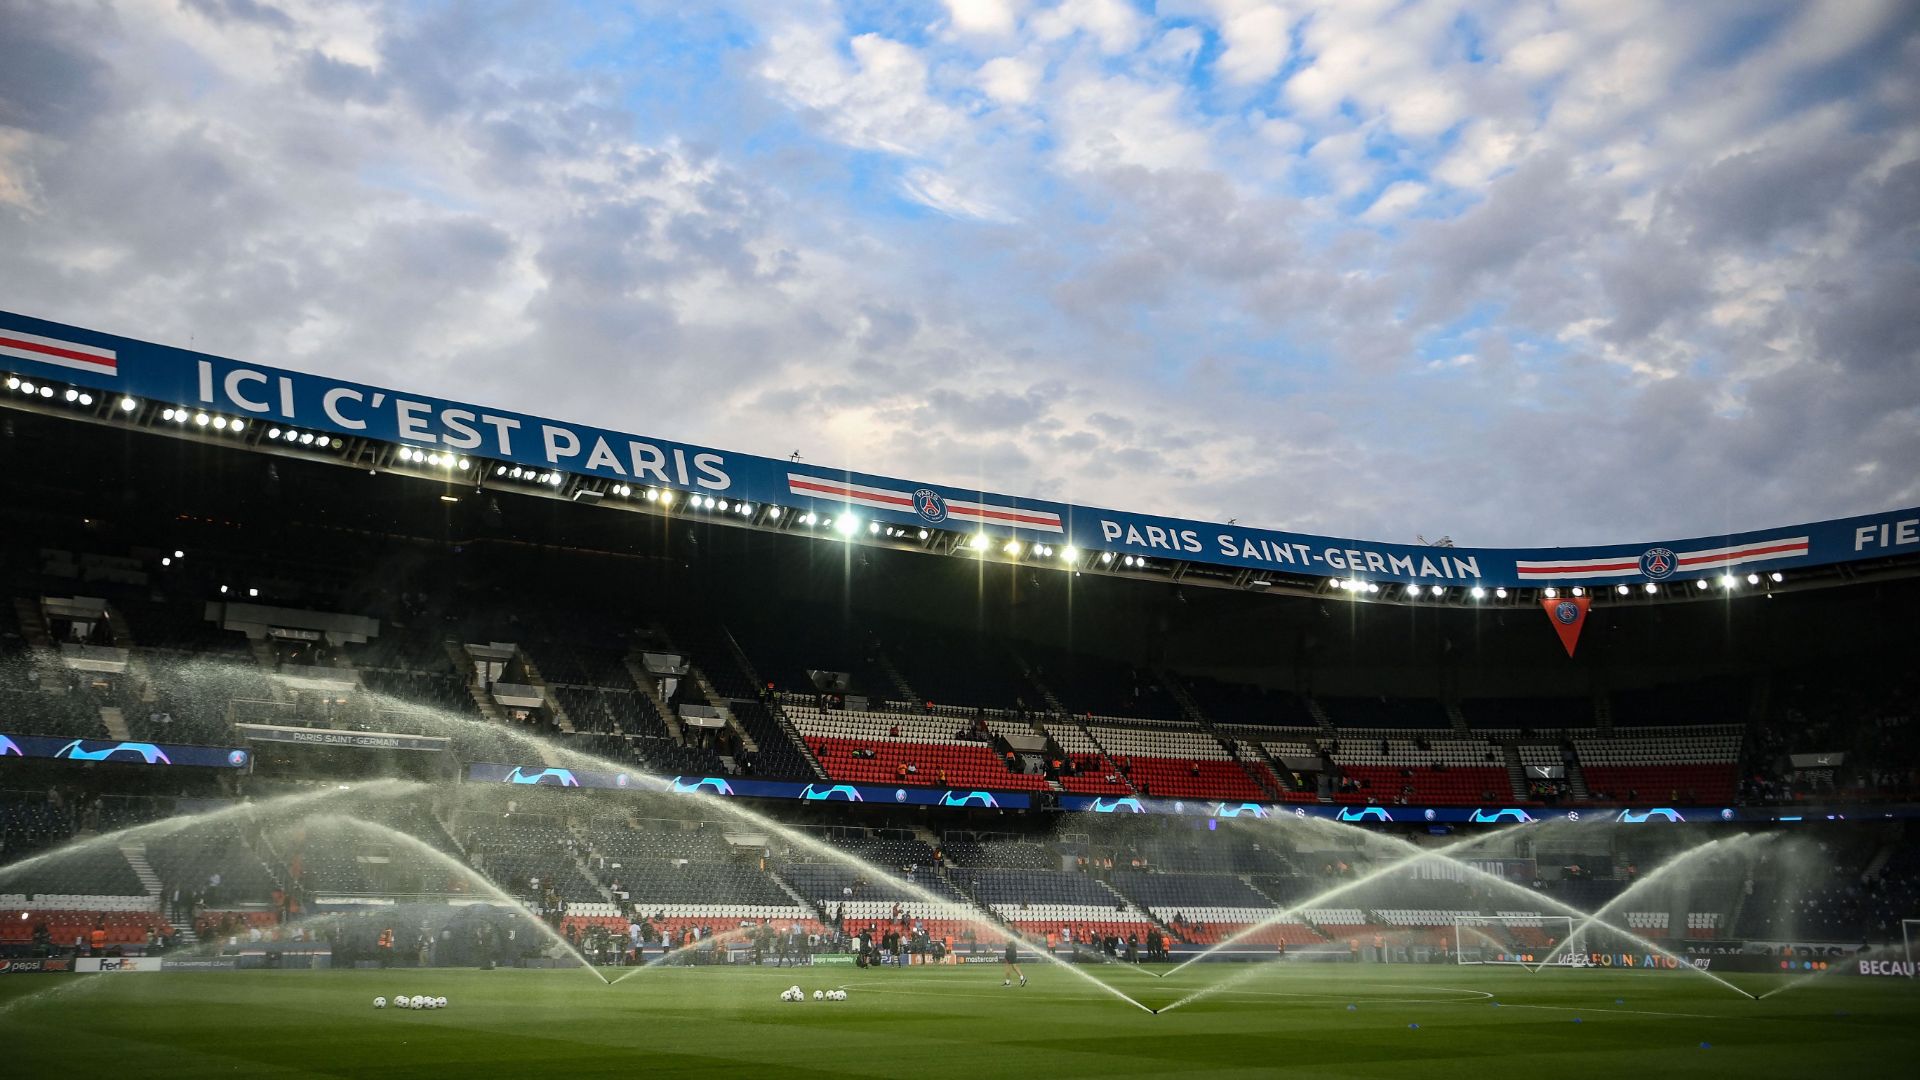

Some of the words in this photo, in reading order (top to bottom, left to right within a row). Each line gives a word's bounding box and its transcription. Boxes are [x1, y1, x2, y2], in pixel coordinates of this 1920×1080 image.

[197, 360, 295, 418] ICI
[322, 387, 521, 455] C'EST
[542, 424, 732, 491] PARIS
[1855, 518, 1920, 551] FIE
[1100, 519, 1203, 553] PARIS
[1216, 535, 1482, 579] SAINT-GERMAIN
[293, 732, 323, 742] PARIS
[324, 734, 400, 747] SAINT-GERMAIN
[12, 960, 40, 972] pepsi
[99, 957, 138, 971] FedEx
[965, 955, 999, 964] mastercard
